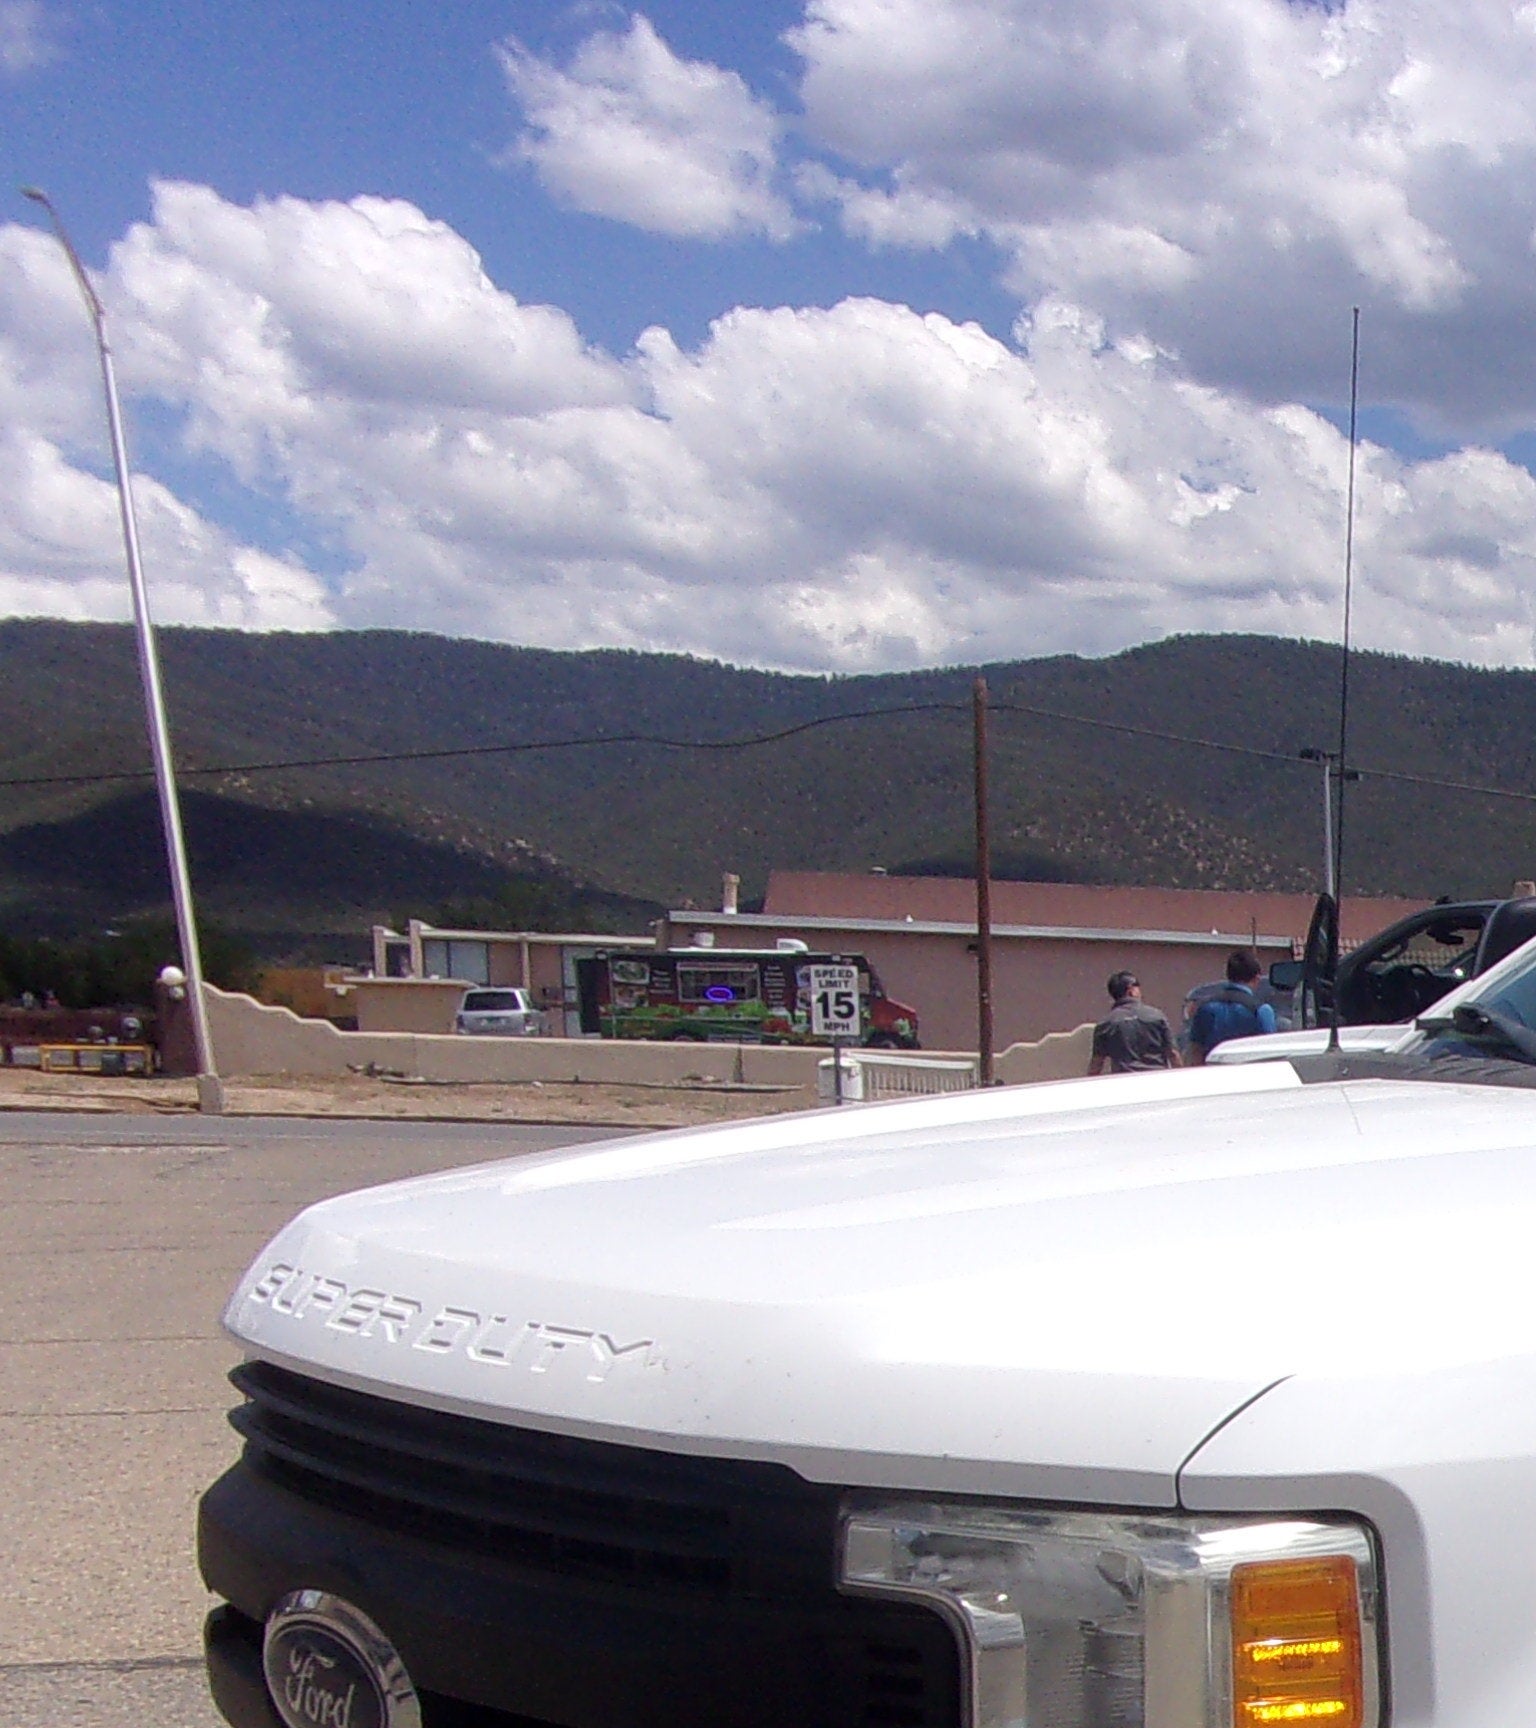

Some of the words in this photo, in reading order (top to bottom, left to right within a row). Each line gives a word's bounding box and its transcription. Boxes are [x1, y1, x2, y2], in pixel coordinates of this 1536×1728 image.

[814, 969, 854, 979] SPEED
[818, 979, 850, 988] LIMIT
[816, 991, 855, 1020] 15
[823, 1021, 850, 1032] MPH
[250, 1262, 423, 1344] SUPER
[411, 1304, 654, 1383] DUTY
